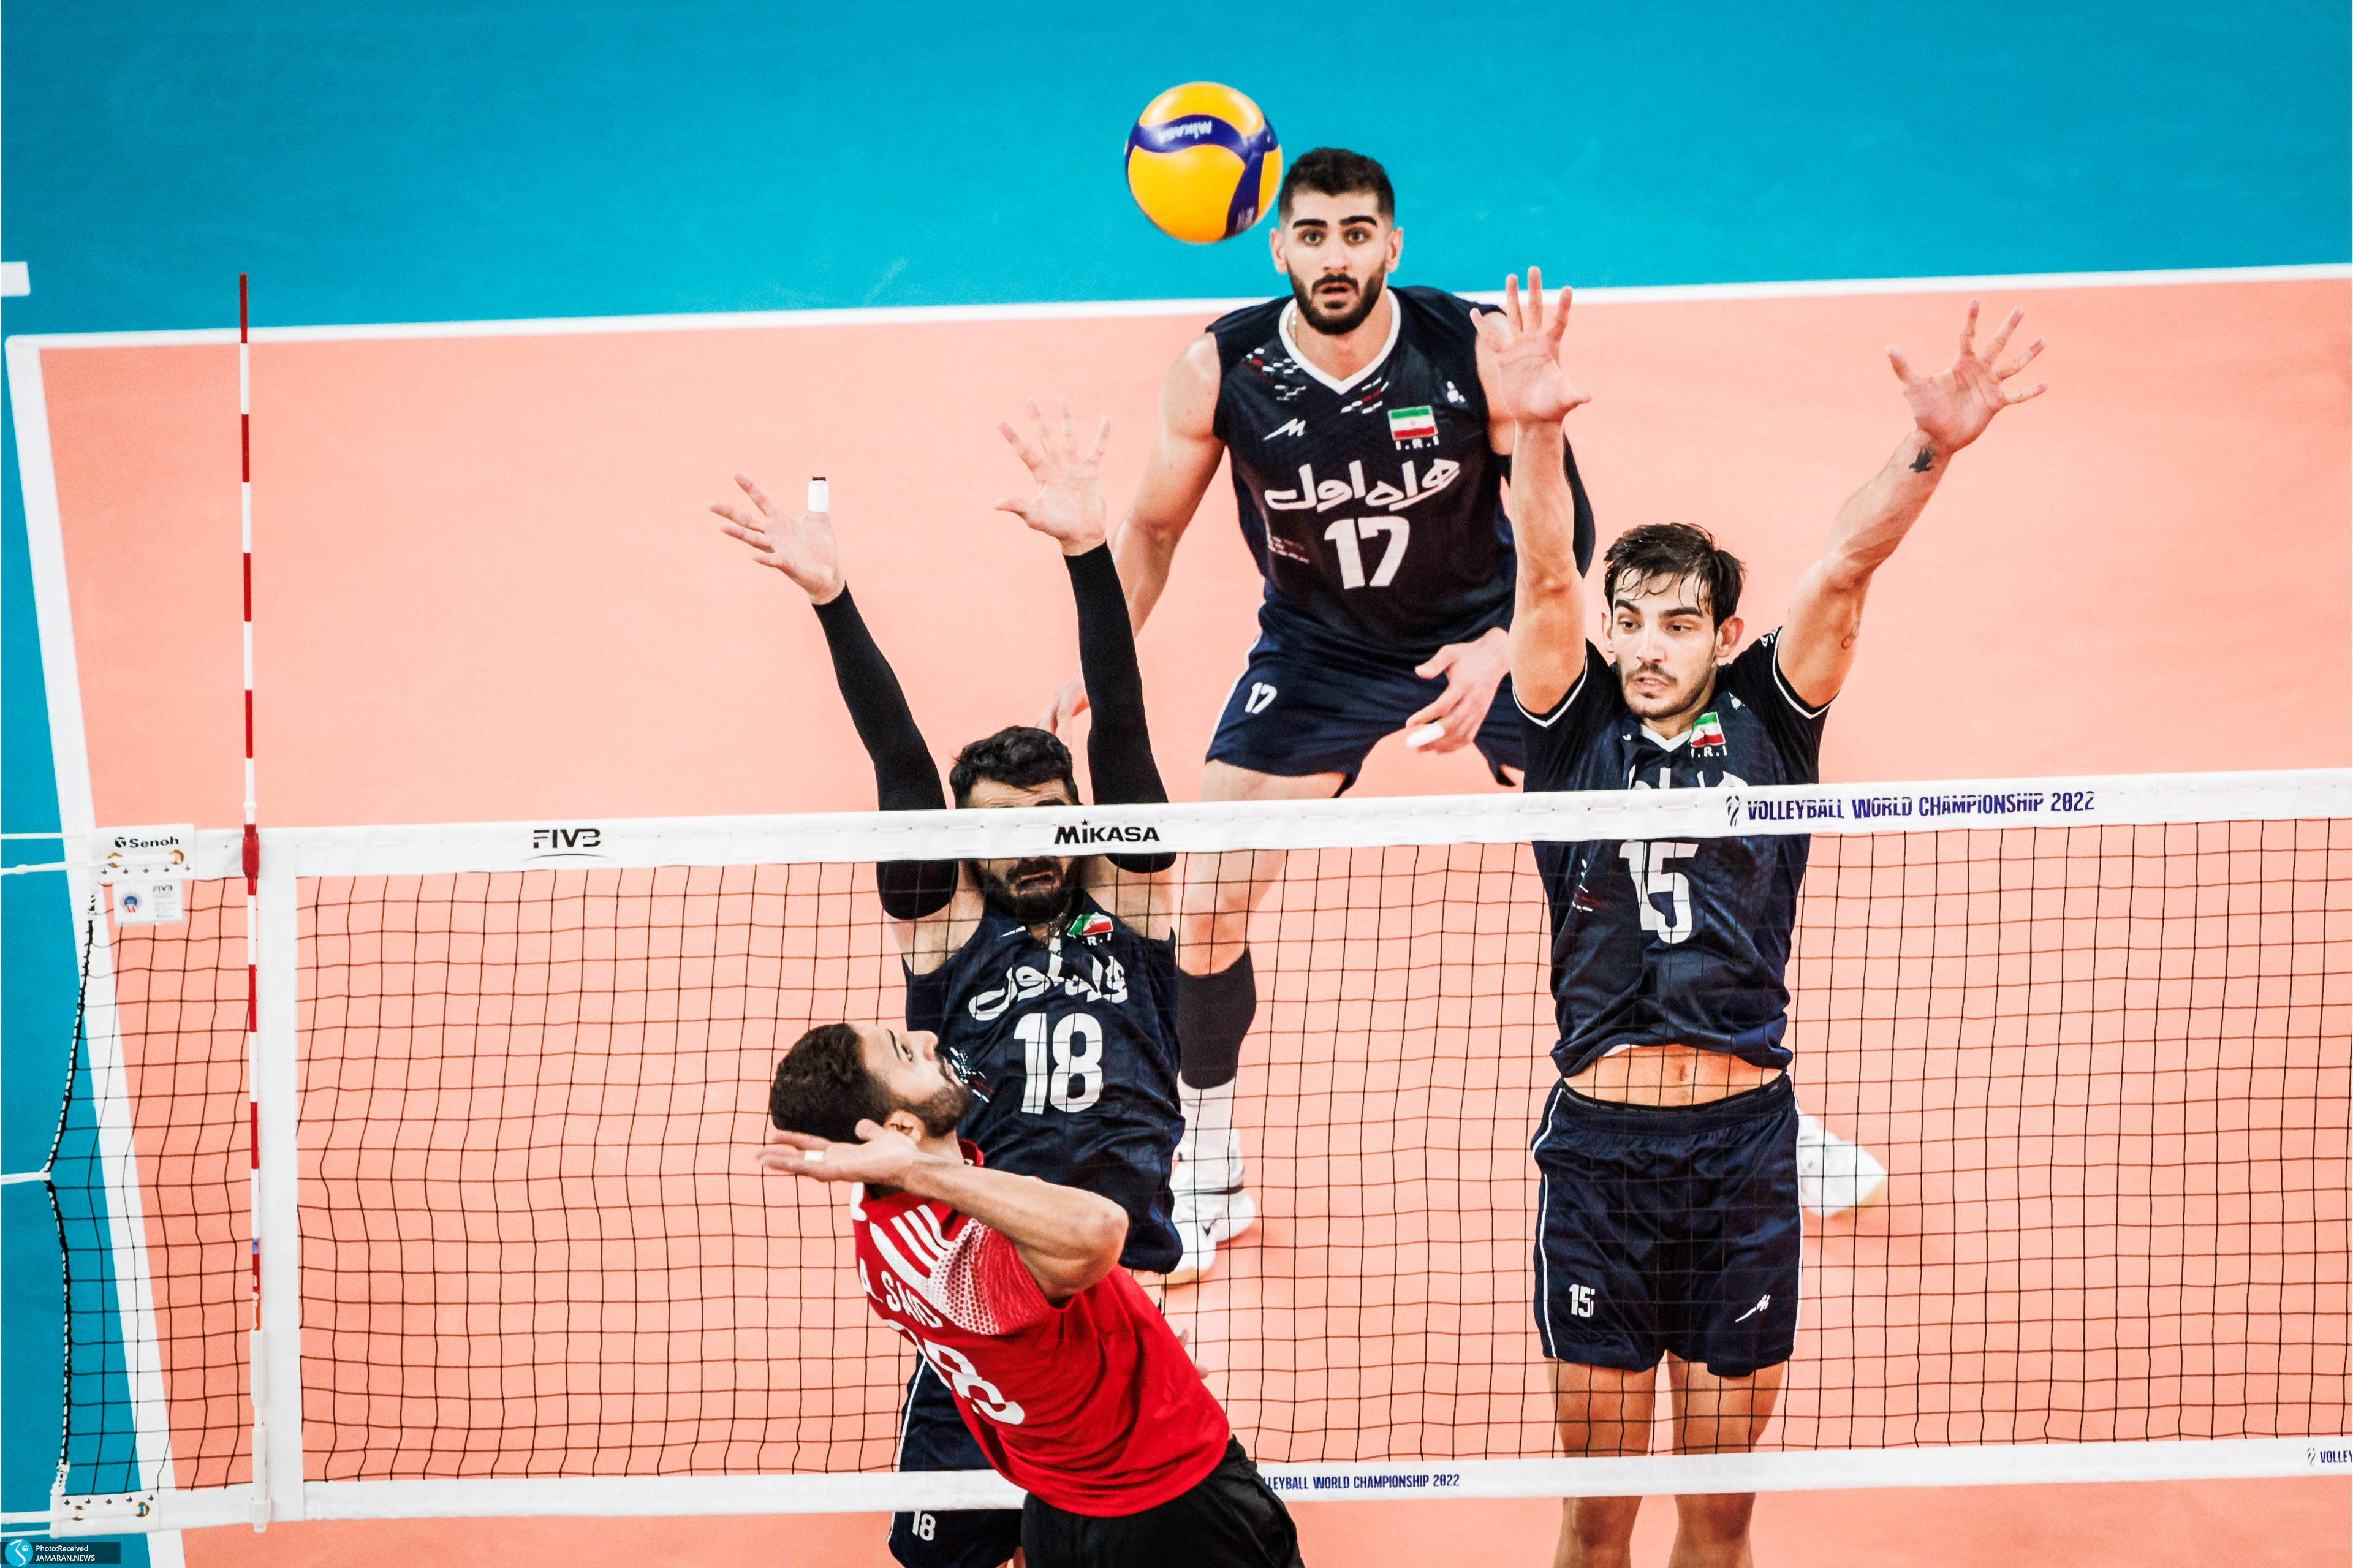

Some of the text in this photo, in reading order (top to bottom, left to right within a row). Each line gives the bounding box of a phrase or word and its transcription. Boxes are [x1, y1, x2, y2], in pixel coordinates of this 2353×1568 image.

[1324, 515, 1410, 589] 17
[1245, 681, 1277, 714] 17
[1748, 790, 2094, 820] VOLLEYBALL WORLD CHAMPIONSHIP 2022
[129, 836, 179, 849] Senoh
[532, 828, 601, 849] FIVB
[1619, 840, 1699, 944] 15
[1014, 1012, 1103, 1115] 18
[1569, 1284, 1596, 1318] 15
[1313, 1476, 1349, 1490] WORLD
[1354, 1474, 1429, 1489] CHAMPIONSHIP
[1433, 1474, 1460, 1487] 2022
[912, 1510, 936, 1541] 18
